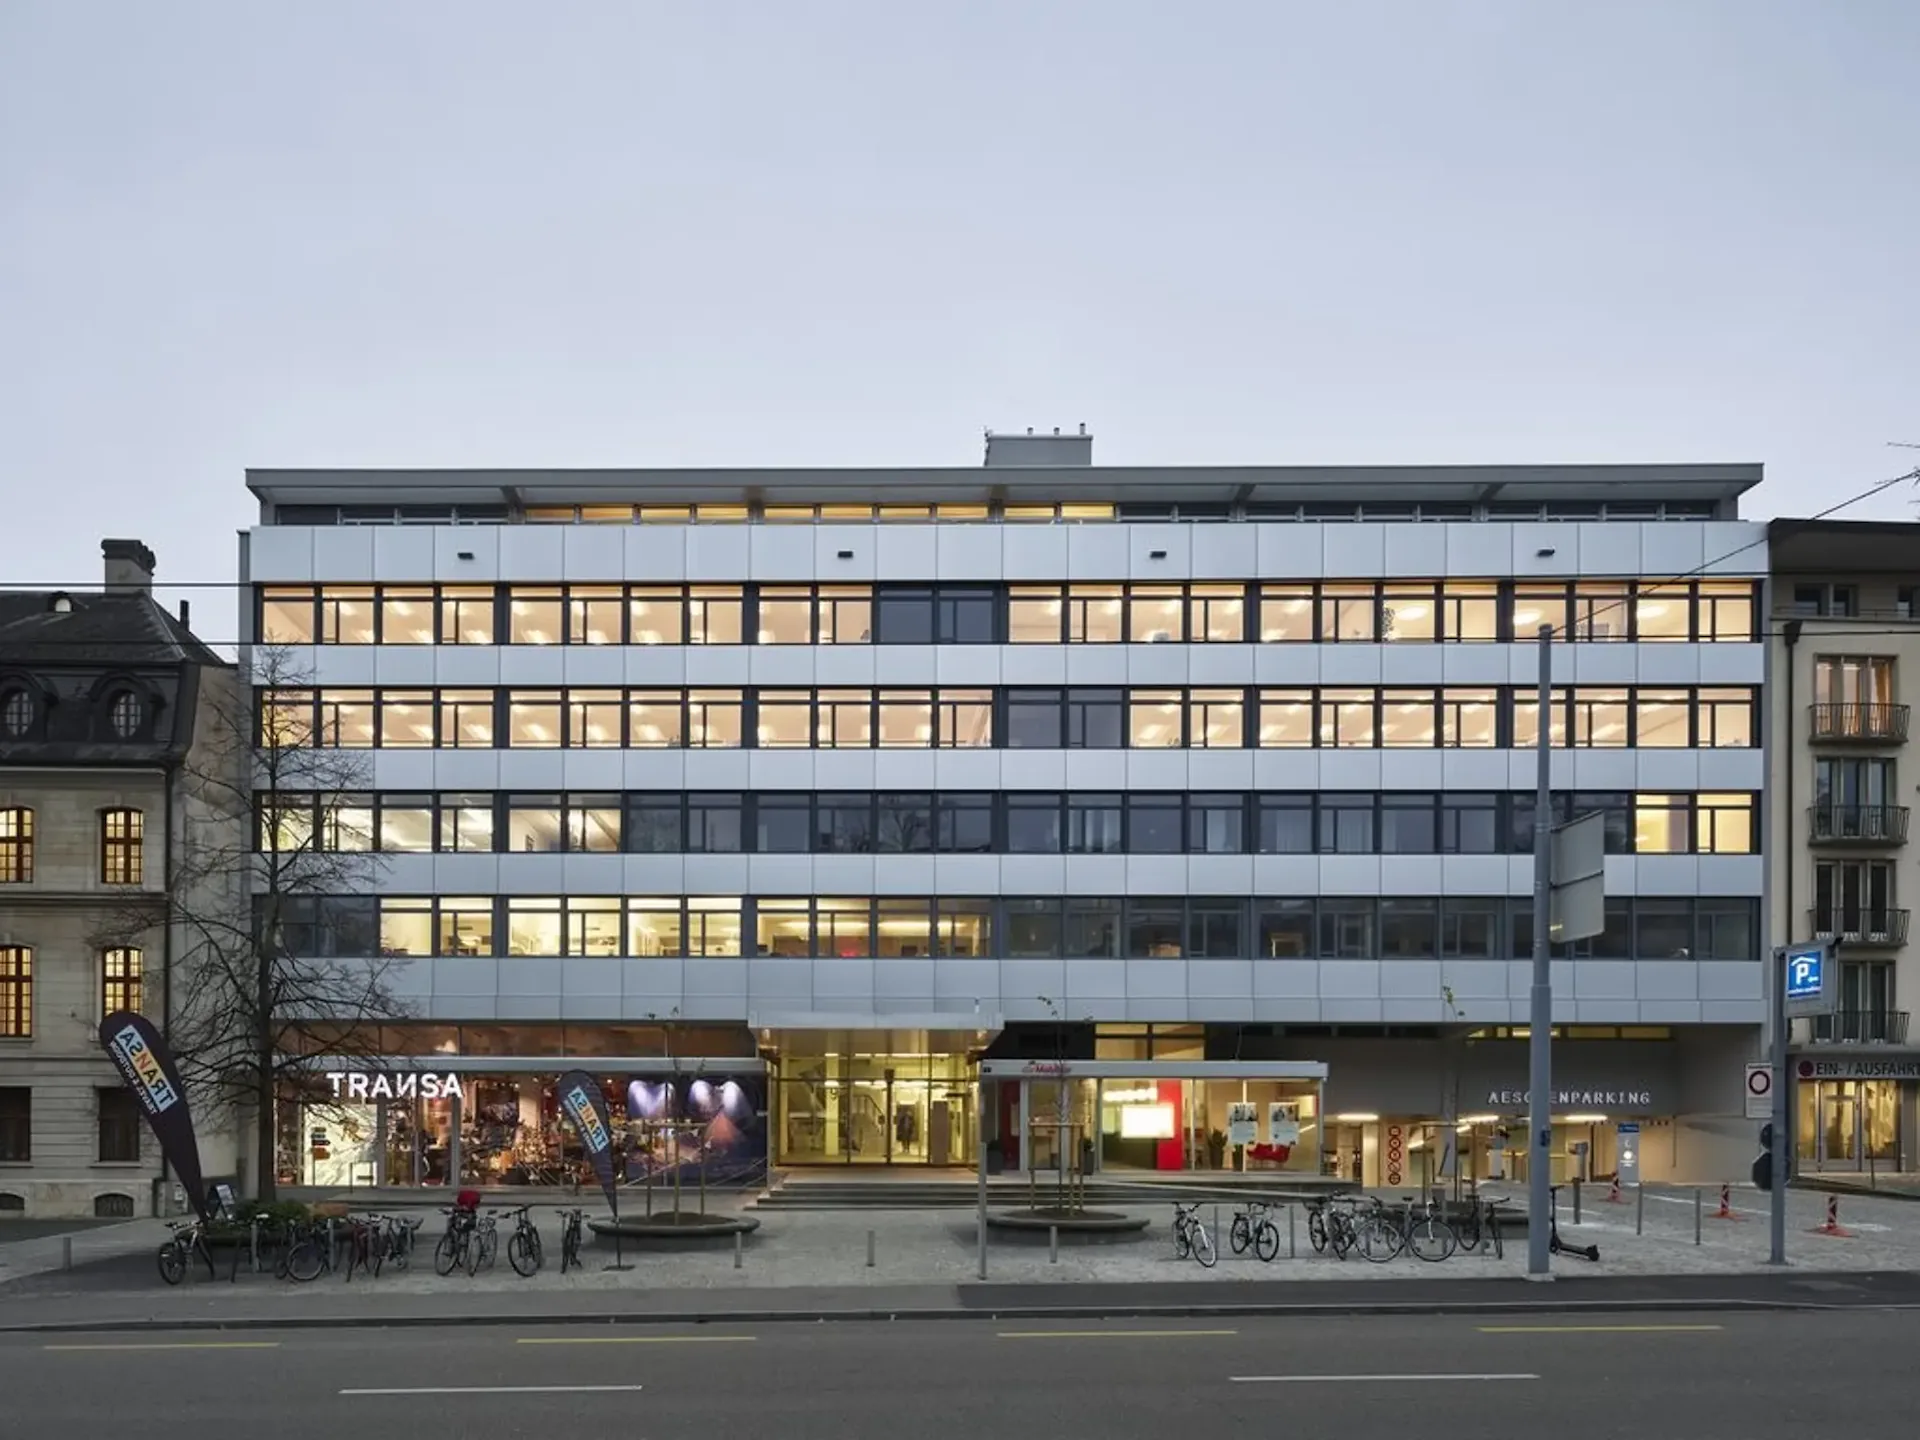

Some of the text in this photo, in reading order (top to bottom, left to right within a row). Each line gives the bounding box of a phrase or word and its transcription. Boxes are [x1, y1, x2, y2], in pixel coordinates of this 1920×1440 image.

[1796, 963, 1808, 985] P
[326, 1072, 463, 1099] TRANSA
[1488, 1090, 1650, 1104] AESCENPARKING
